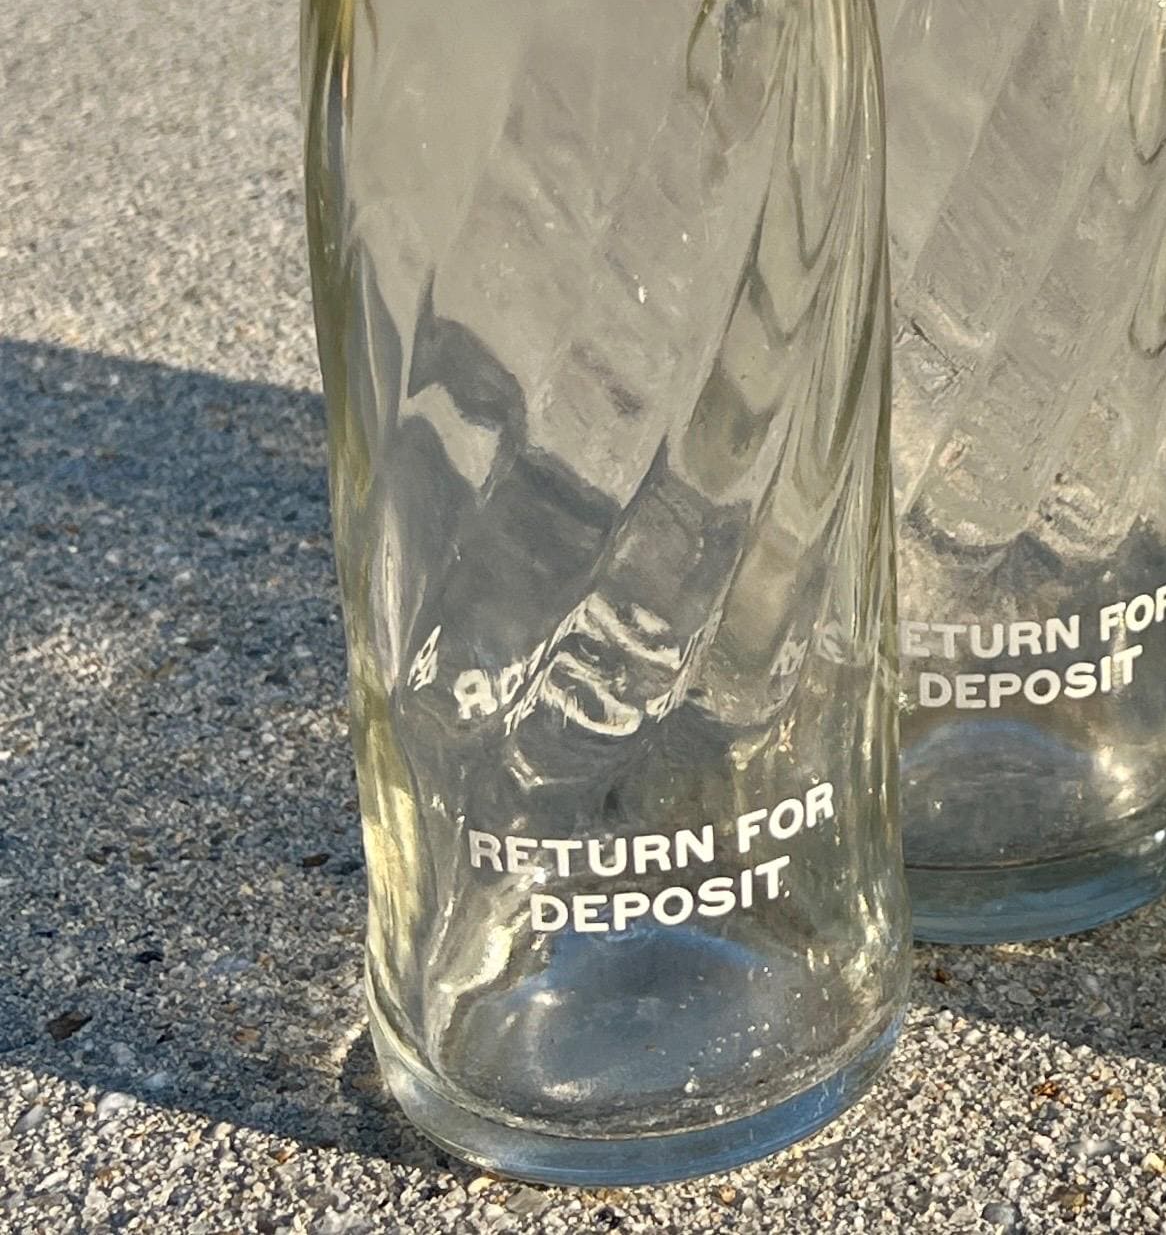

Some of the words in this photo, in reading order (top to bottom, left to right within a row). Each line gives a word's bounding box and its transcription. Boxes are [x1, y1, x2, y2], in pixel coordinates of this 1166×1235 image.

[900, 615, 1080, 659] ETURN
[919, 644, 1143, 709] DEPOSIT
[469, 824, 715, 877] RETURN
[737, 781, 835, 853] FOR
[530, 856, 790, 933] DEPOSIT
